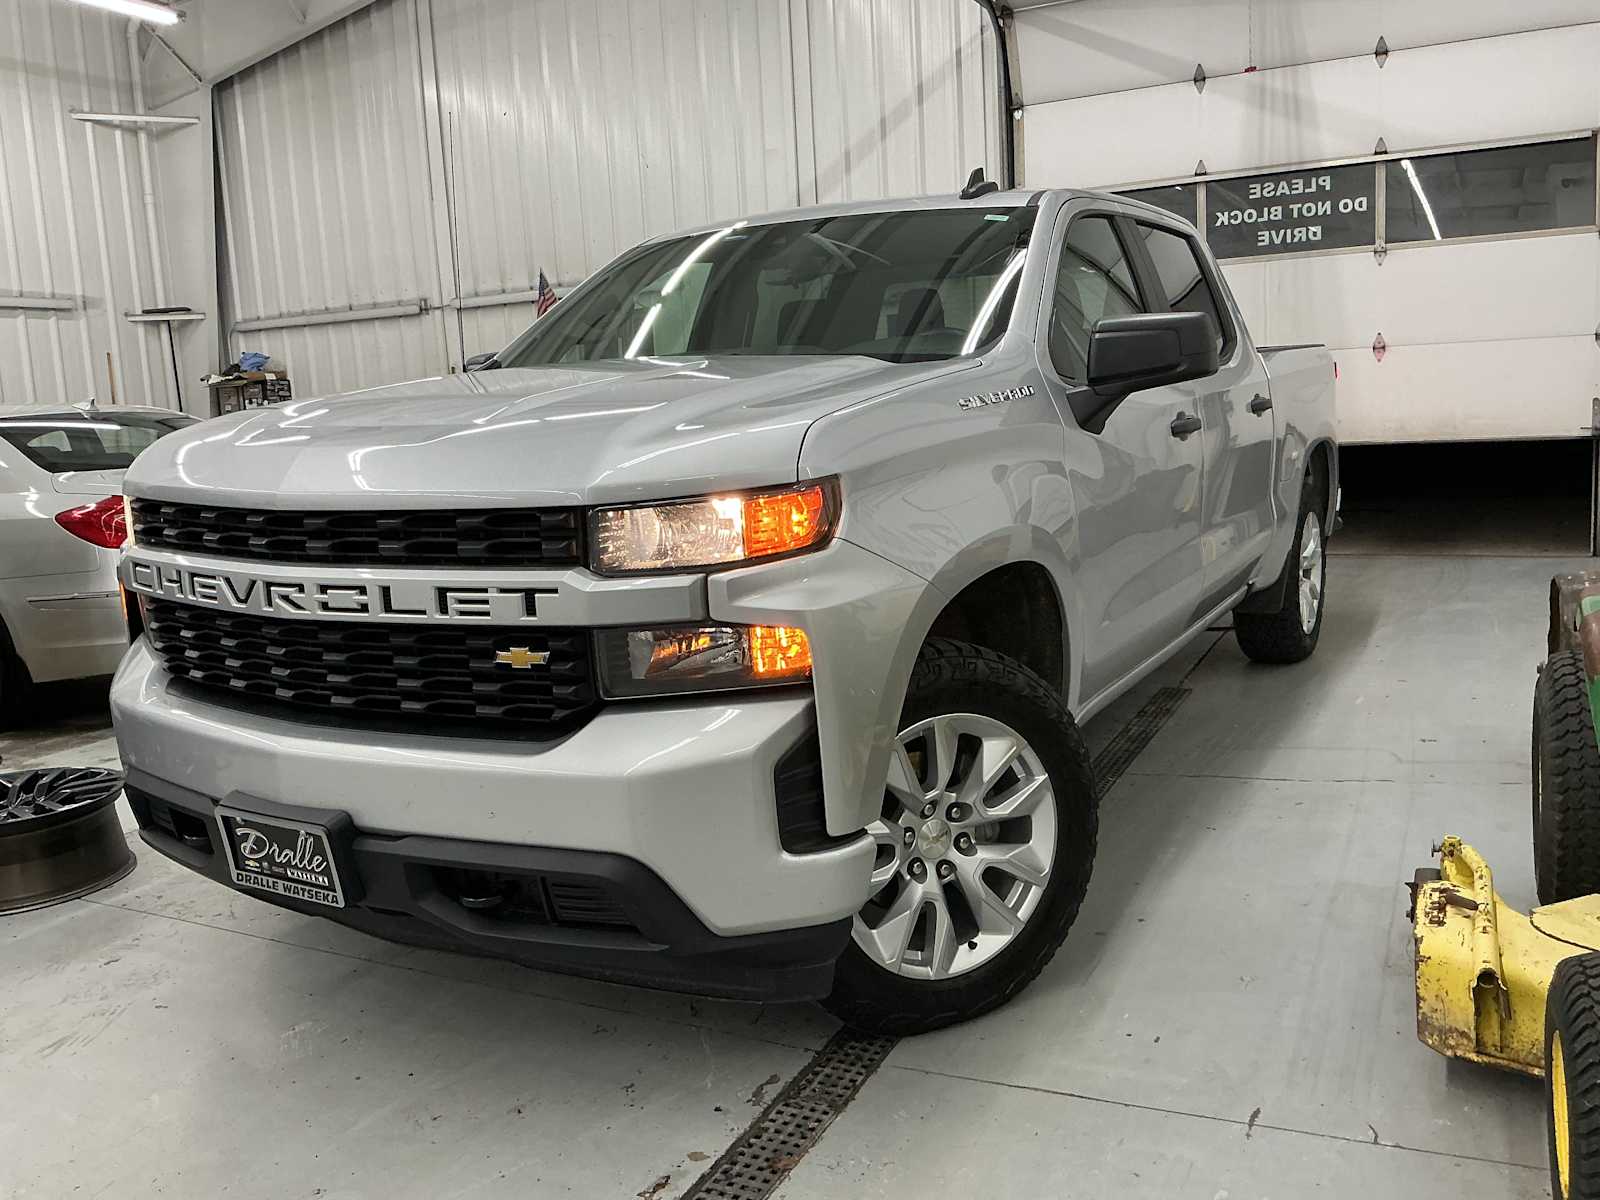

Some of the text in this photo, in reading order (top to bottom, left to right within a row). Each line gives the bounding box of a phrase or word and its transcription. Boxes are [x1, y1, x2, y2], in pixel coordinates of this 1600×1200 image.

[959, 385, 1034, 410] SILVERADO
[130, 561, 559, 620] CHEVROLET
[235, 827, 327, 872] Dralle
[236, 872, 339, 905] DRALLE WATSEKA
